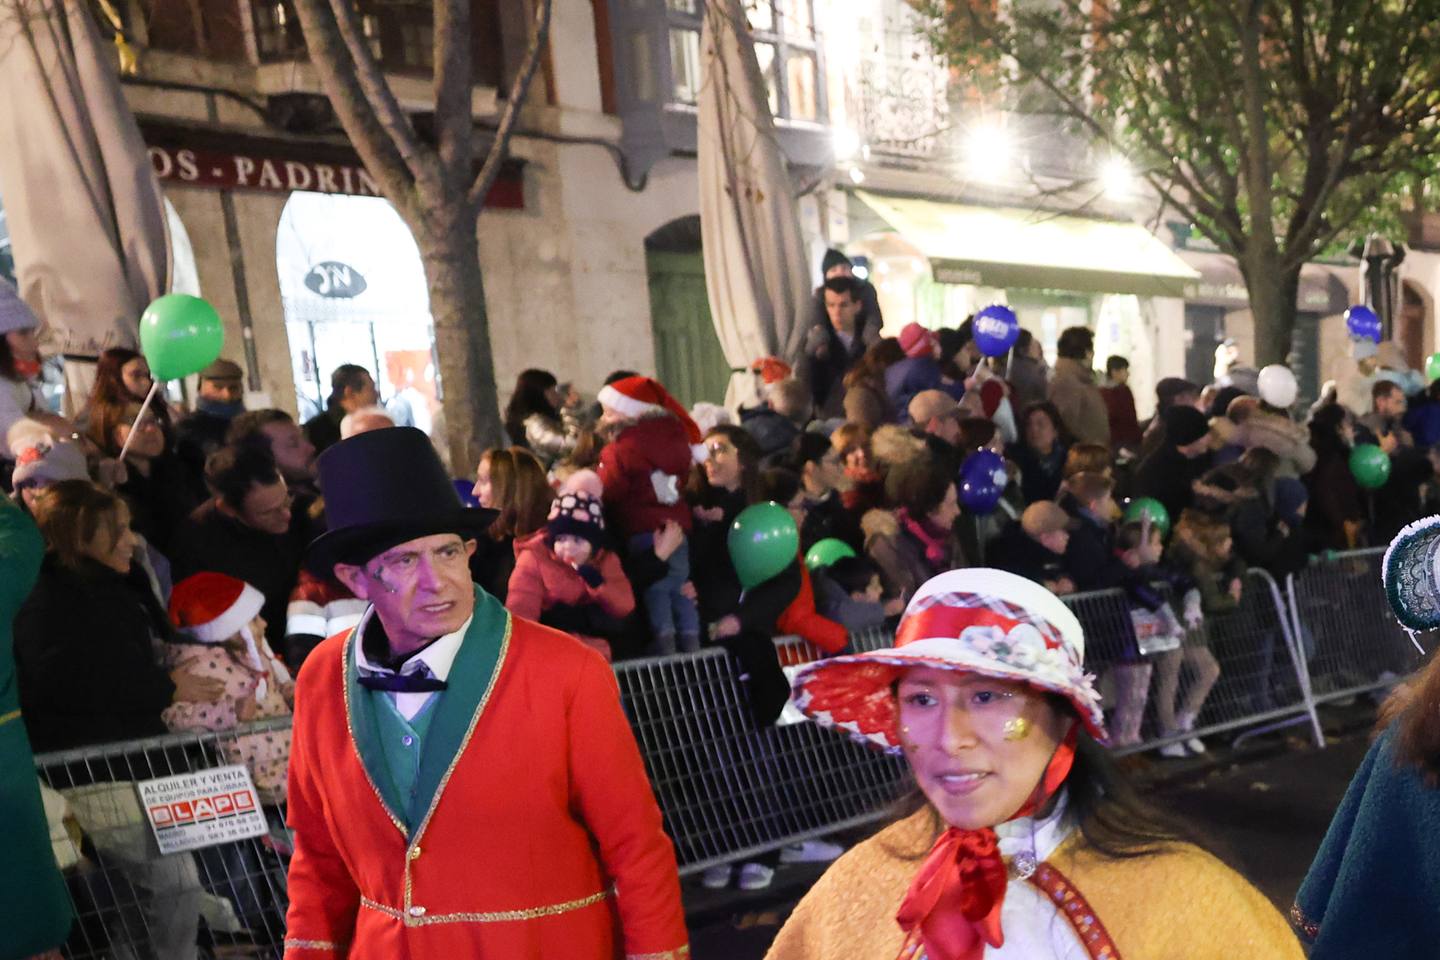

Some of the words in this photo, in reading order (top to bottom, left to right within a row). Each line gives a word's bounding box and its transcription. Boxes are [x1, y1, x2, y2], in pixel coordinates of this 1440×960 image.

[144, 776, 198, 796] ALQUILER
[201, 776, 207, 785] Y
[209, 771, 245, 784] VENTA
[159, 790, 196, 802] EQUIPOS
[197, 786, 219, 796] PARA
[222, 781, 248, 792] OBRAS
